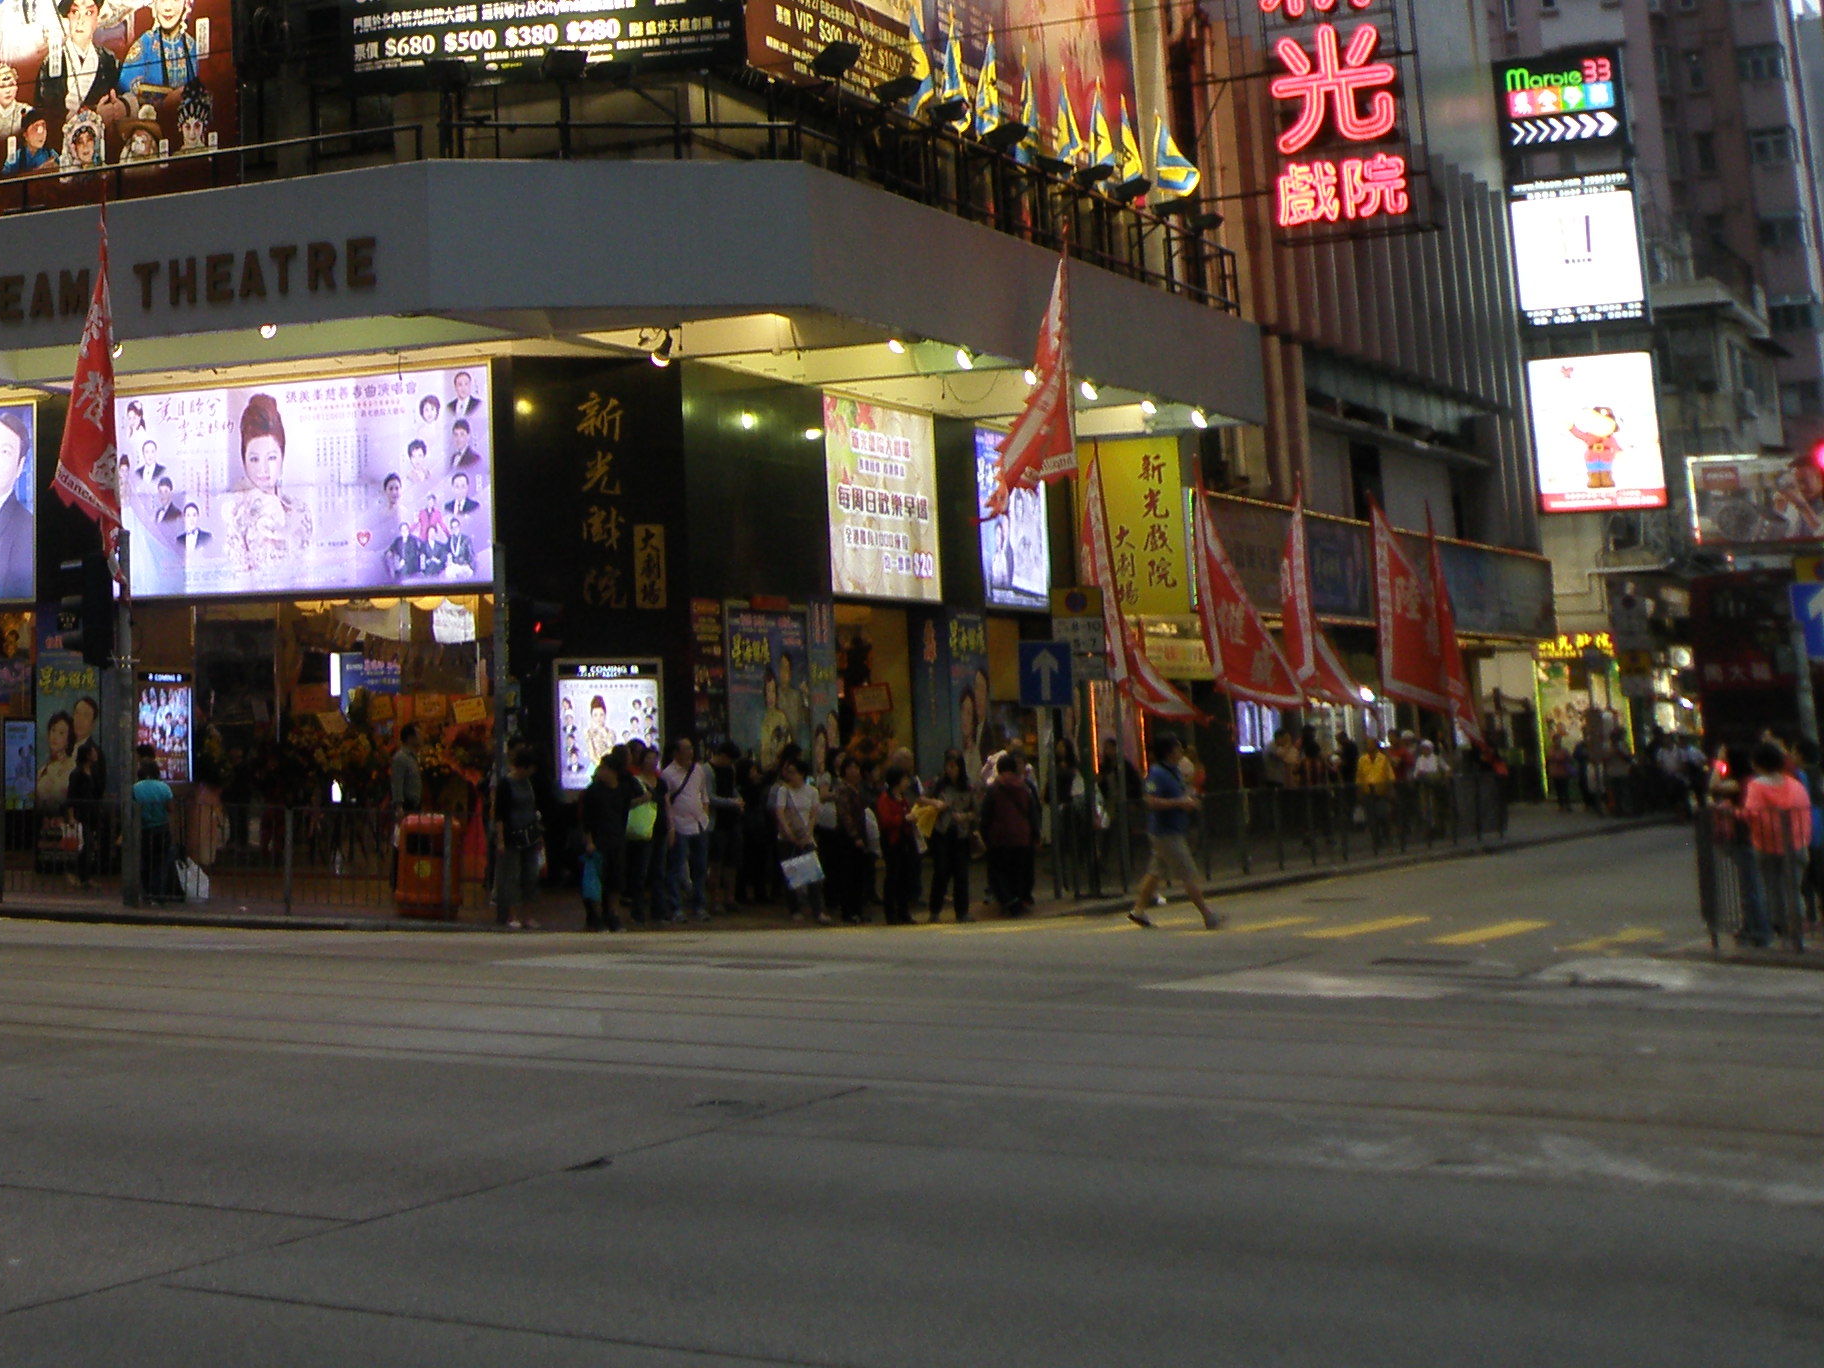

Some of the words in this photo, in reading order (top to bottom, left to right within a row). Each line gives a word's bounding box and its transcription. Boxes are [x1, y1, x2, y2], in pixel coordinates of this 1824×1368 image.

[384, 34, 435, 57] $680
[444, 29, 497, 53] $500
[505, 23, 559, 48] $380
[795, 8, 814, 33] VIP
[1506, 67, 1583, 92] Marble
[1582, 56, 1612, 83] 33
[1278, 153, 1408, 227] 戲院
[132, 237, 377, 310] THEATRE
[577, 391, 628, 609] 新光戲院
[1138, 454, 1177, 589] 新光戲院
[638, 528, 663, 606] 大劇場
[912, 552, 934, 578] $20
[1114, 525, 1140, 606] 大劇場
[590, 664, 626, 674] COMING
